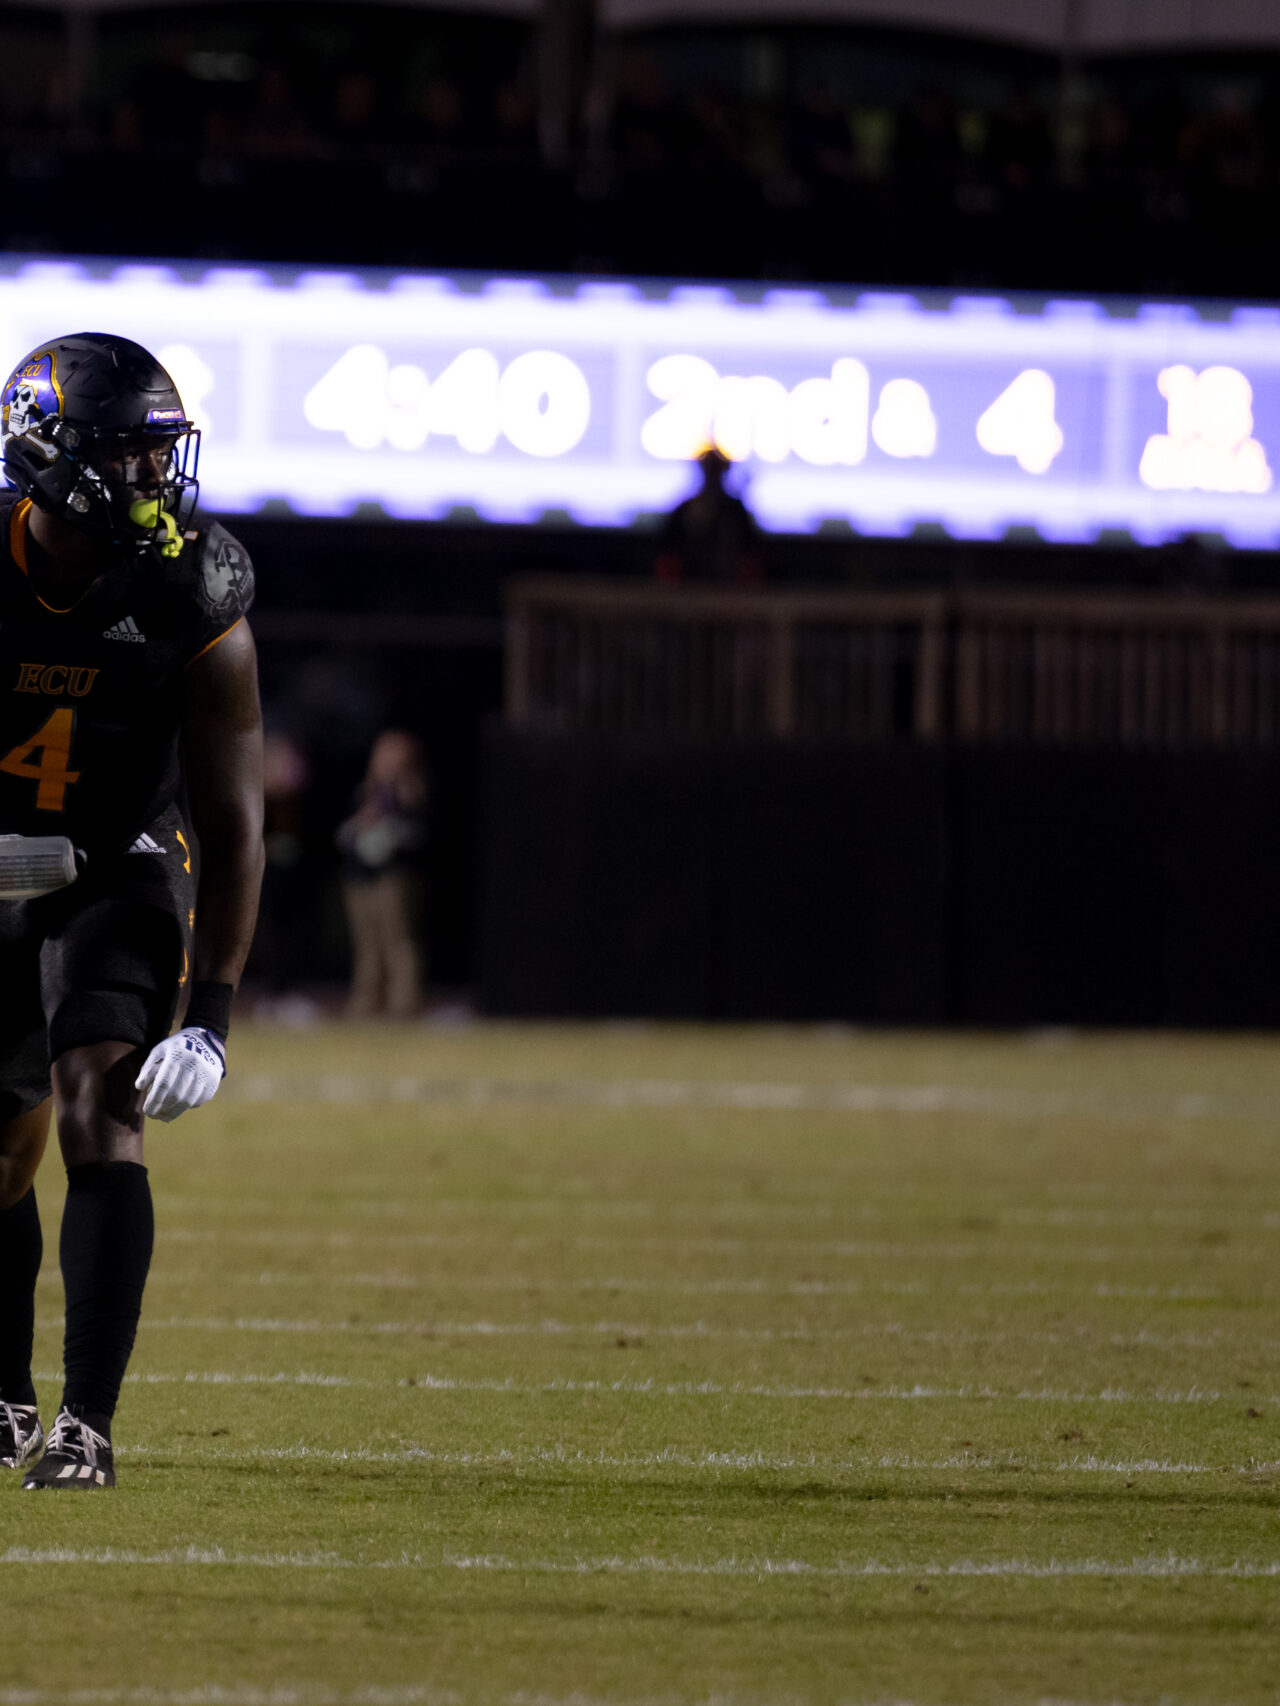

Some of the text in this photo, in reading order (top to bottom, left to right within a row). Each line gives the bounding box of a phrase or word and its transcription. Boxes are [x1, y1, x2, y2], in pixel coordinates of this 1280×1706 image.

[20, 364, 46, 378] ECU
[304, 344, 591, 457] 4:40
[640, 354, 870, 465] 2nd
[976, 369, 1064, 474] 4
[13, 663, 101, 697] ECU
